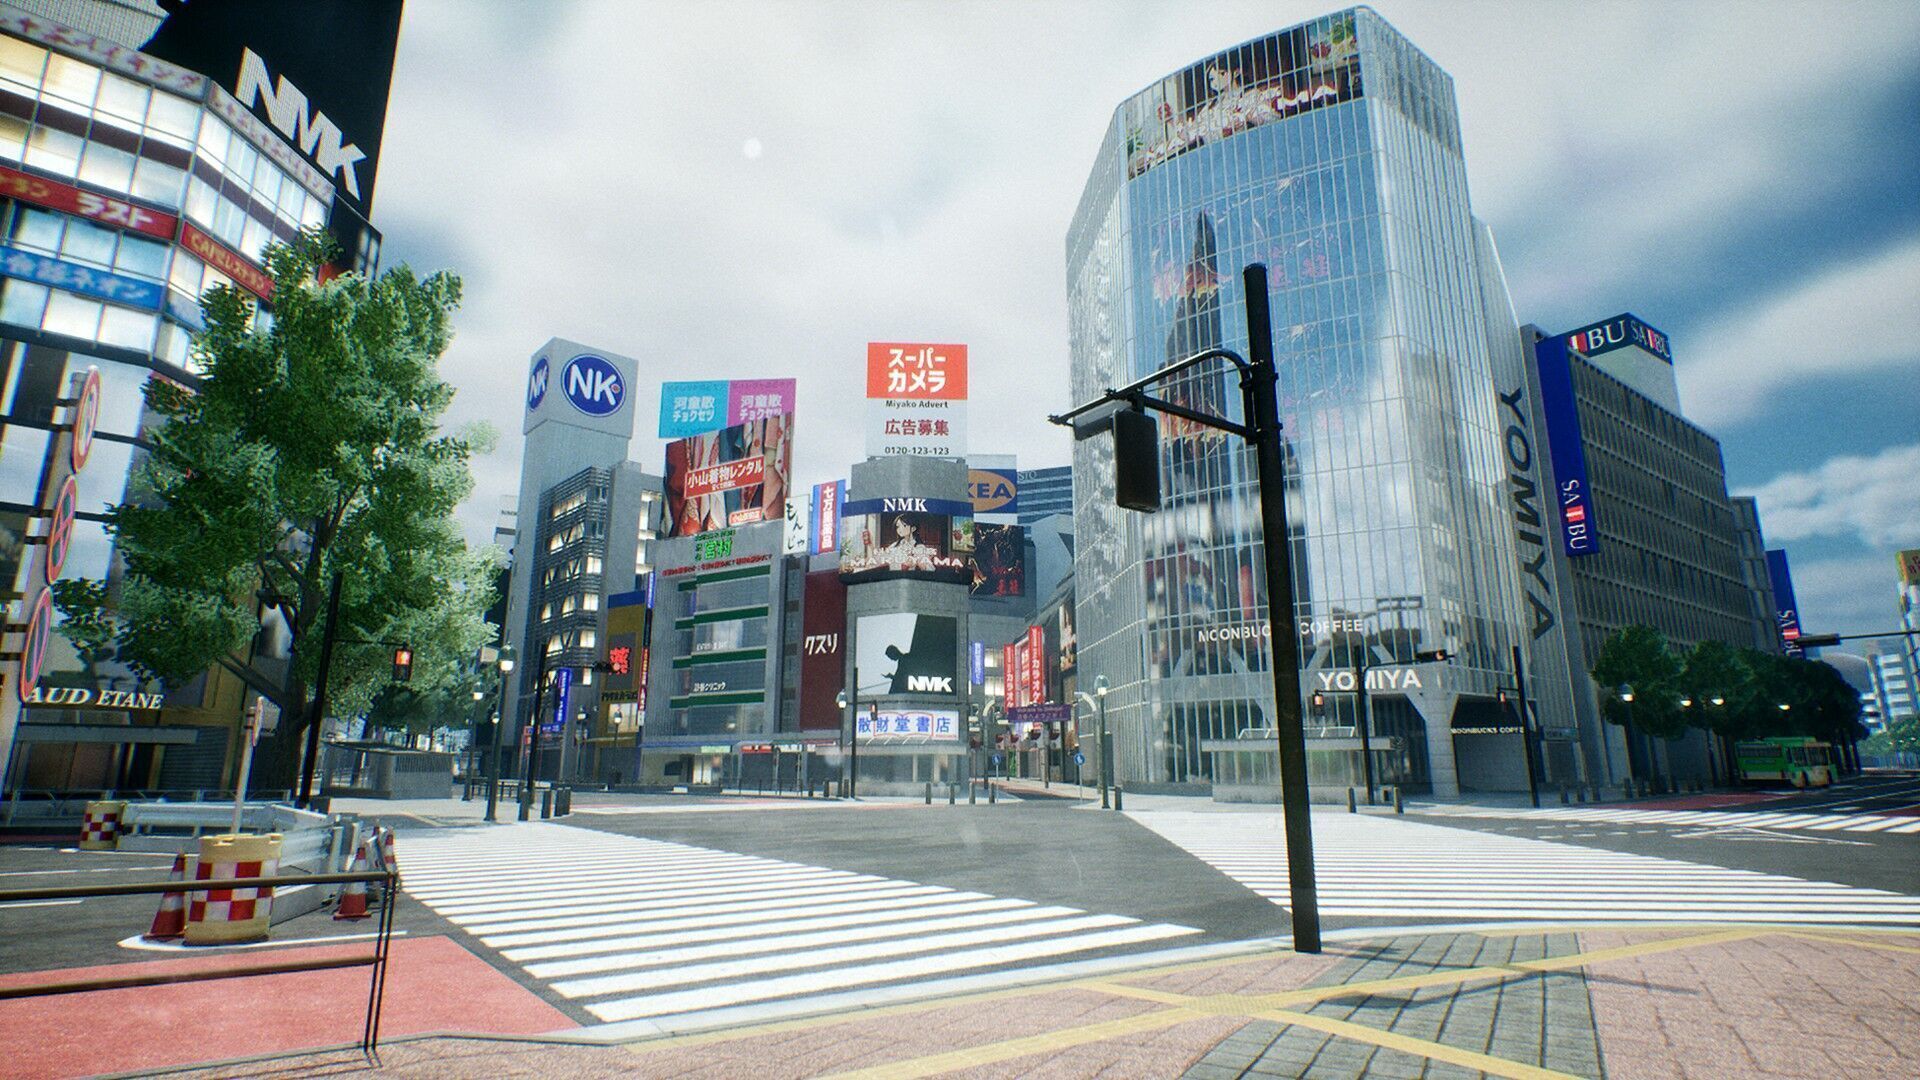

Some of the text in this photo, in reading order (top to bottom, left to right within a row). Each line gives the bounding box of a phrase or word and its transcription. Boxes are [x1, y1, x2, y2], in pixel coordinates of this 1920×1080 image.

[236, 46, 367, 202] NMK
[77, 191, 154, 229] ラスト
[888, 348, 946, 369] スーパー
[567, 363, 615, 406] NK
[887, 368, 946, 393] カメラ
[885, 400, 949, 409] Miyako Advert
[885, 418, 950, 436] 広告募集
[885, 446, 950, 455] 0120-123-123
[883, 498, 927, 513] NMK
[1501, 387, 1554, 640] YOMIYA
[785, 502, 805, 550] もんじゃ
[1300, 619, 1364, 635] COFFEE
[804, 633, 838, 656] クスリ
[907, 675, 953, 693] NMK
[96, 689, 163, 710] ETANE
[858, 716, 951, 733] 散財堂書店
